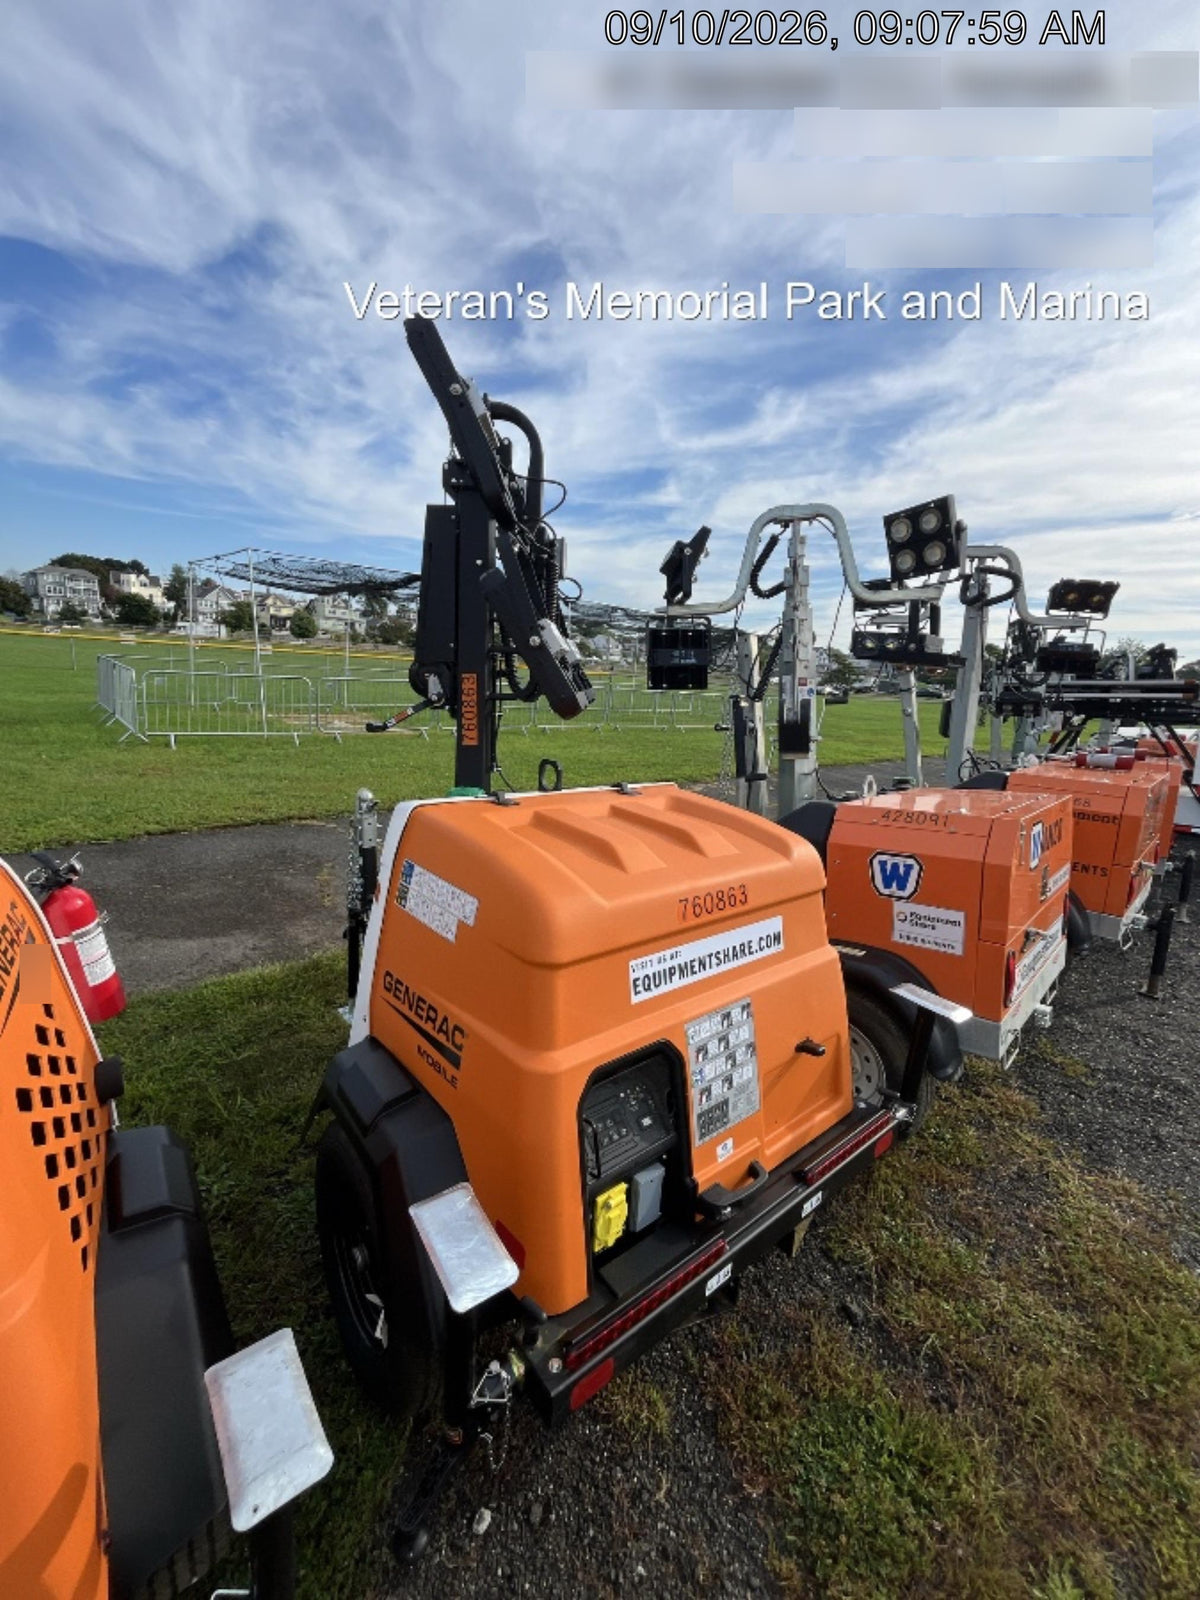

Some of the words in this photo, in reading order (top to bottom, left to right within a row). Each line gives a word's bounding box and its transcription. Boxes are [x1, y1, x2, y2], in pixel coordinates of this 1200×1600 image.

[881, 810, 949, 827] 428091
[878, 860, 915, 892] W
[678, 884, 749, 921] 760863
[632, 930, 782, 996] EQUIPMENTSHARE.COM
[383, 970, 465, 1052] GENERAC
[416, 1043, 459, 1090] MOBILE
